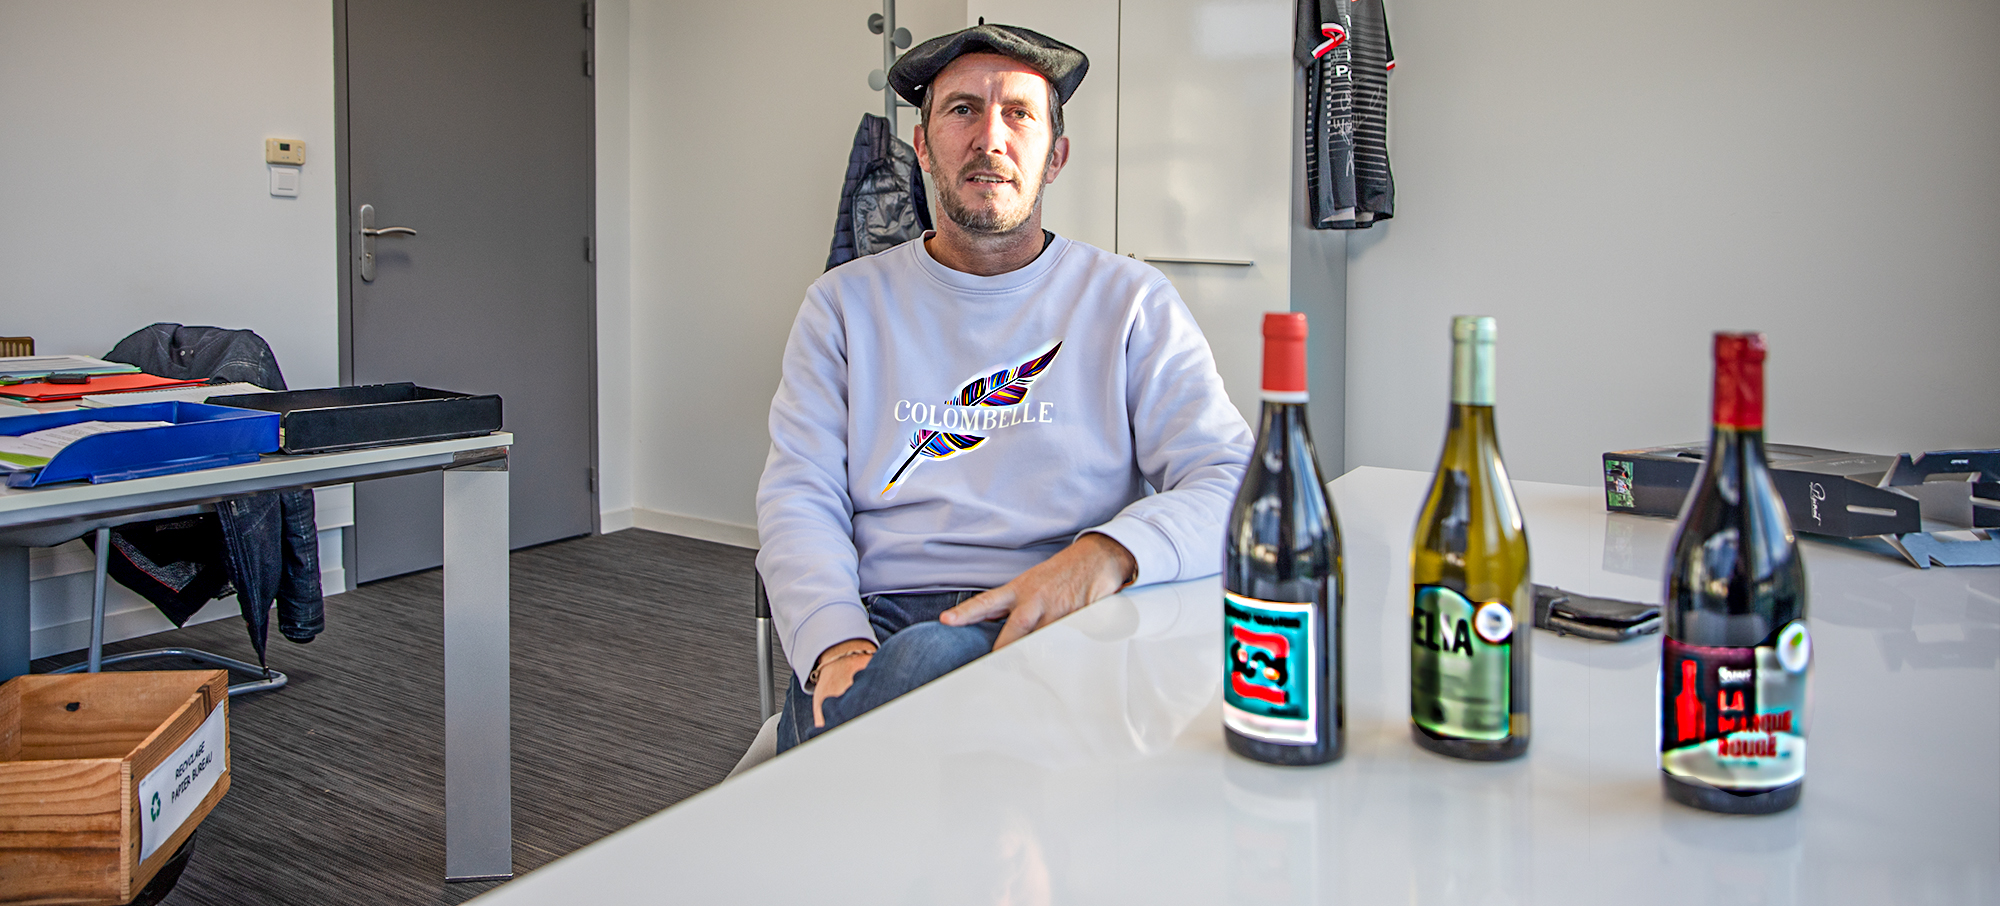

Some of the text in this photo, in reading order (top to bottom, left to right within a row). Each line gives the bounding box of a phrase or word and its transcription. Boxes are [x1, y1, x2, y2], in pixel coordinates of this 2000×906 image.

[894, 400, 1054, 431] COLOMBELLE
[1717, 689, 1745, 711] LA
[171, 750, 213, 804] PAPIER BUREAU
[174, 740, 206, 780] RECYCLAGE
